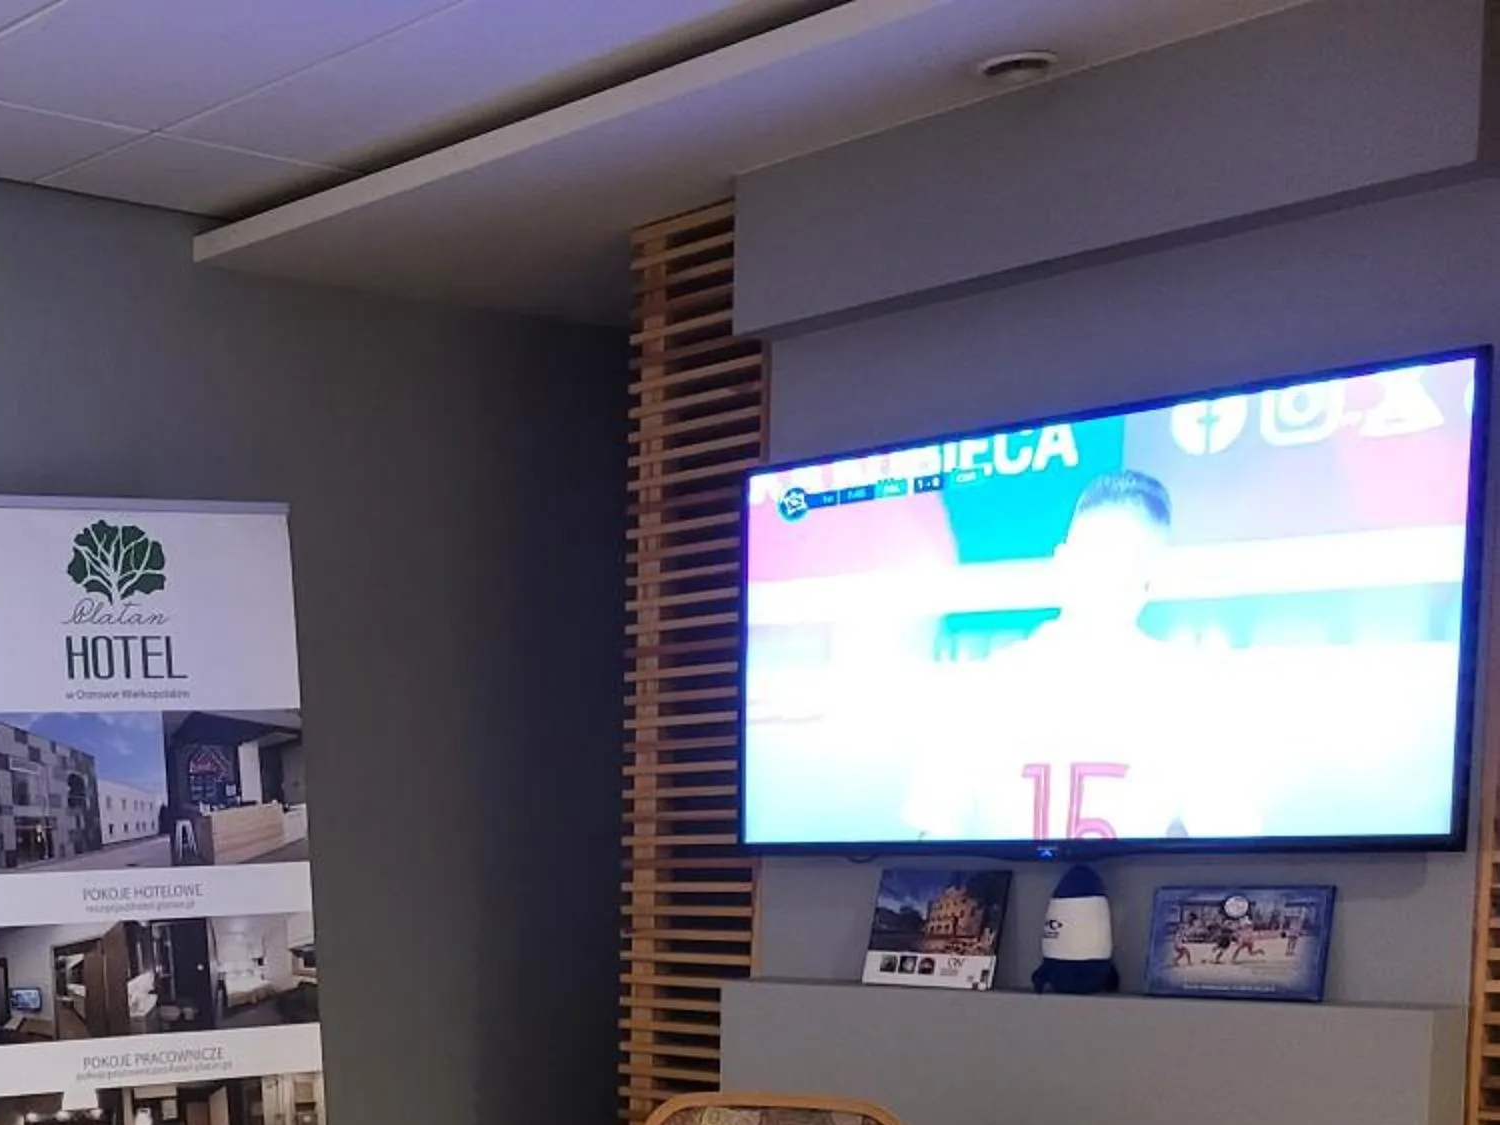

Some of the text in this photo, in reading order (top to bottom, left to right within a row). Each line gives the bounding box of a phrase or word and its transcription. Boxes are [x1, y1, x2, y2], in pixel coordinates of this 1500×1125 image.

[61, 598, 171, 625] Platan
[65, 635, 188, 680] HOTEL
[83, 882, 204, 901] POKOJE HOTELOWE
[83, 1047, 224, 1070] POKOJE PRACOWNICZE
